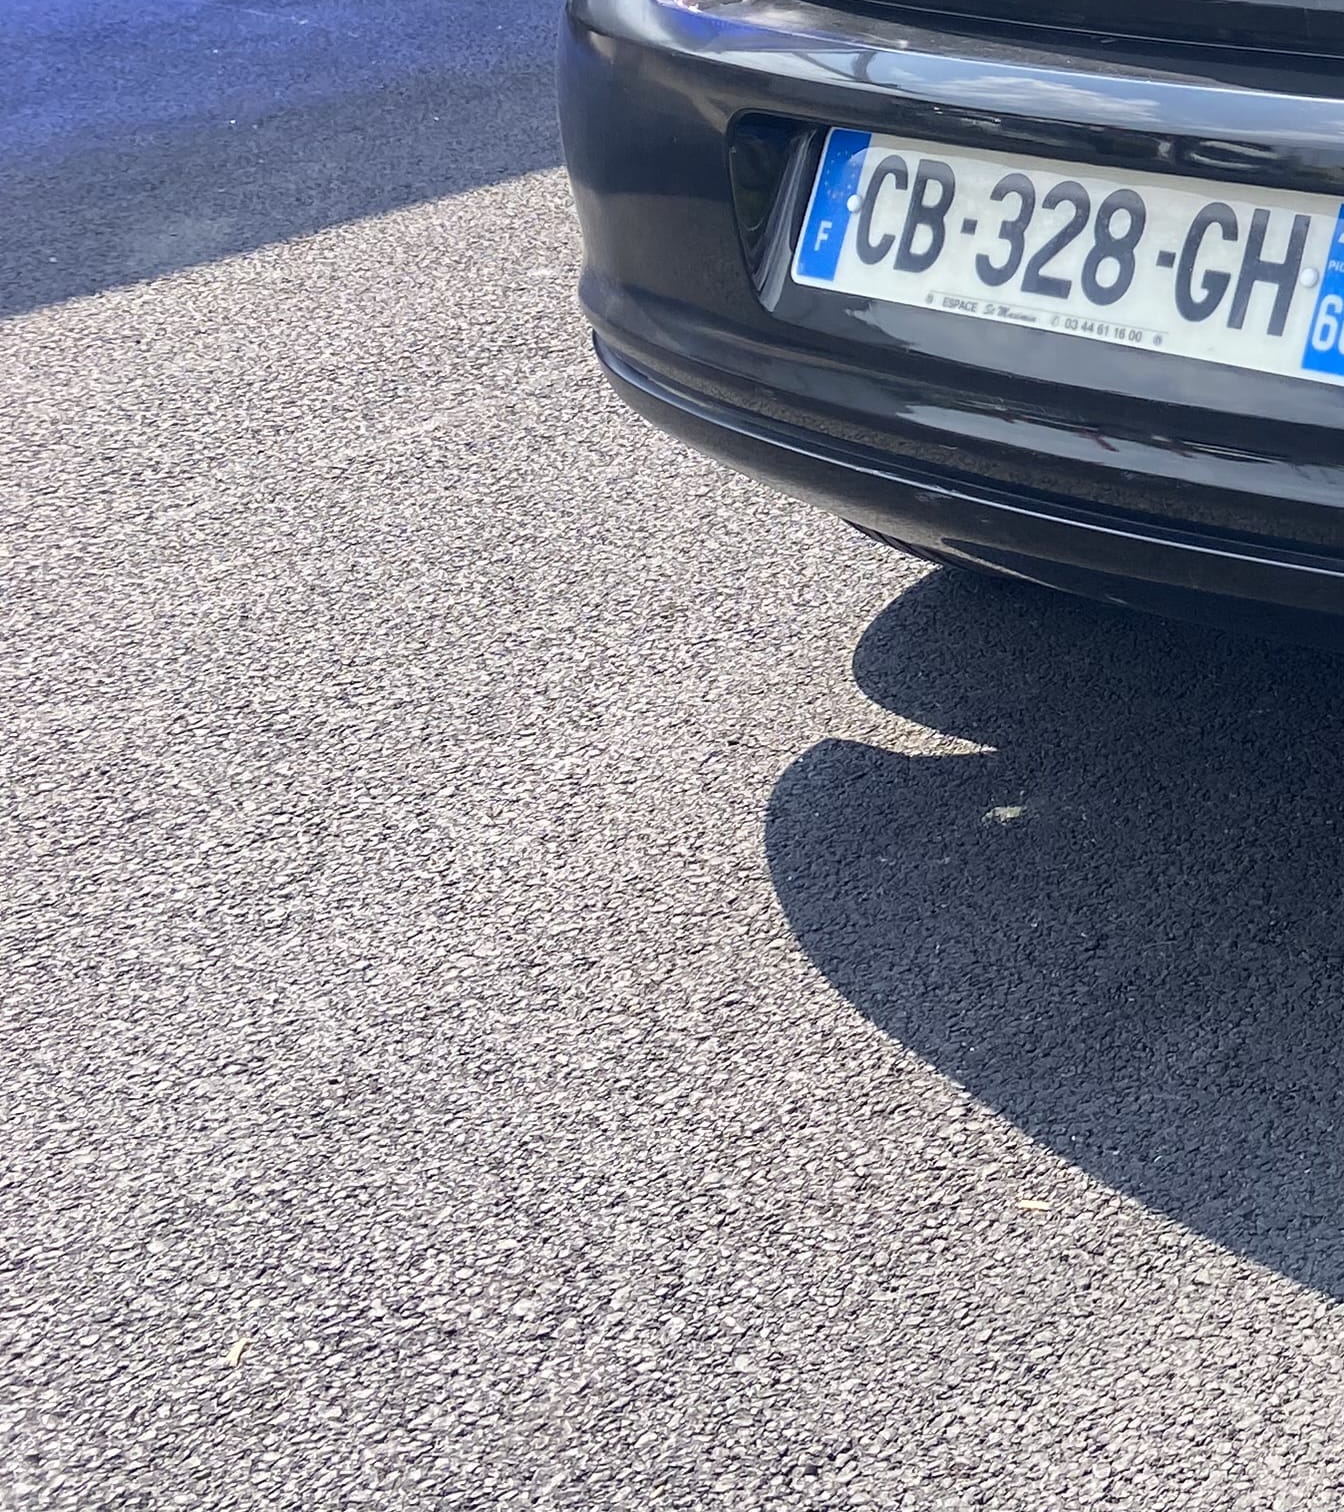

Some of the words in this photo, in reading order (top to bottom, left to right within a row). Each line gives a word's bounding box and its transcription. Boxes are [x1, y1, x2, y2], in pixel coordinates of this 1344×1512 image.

[814, 220, 832, 251] F
[856, 154, 1310, 337] CB-328-GH
[942, 296, 979, 313] ESPACE
